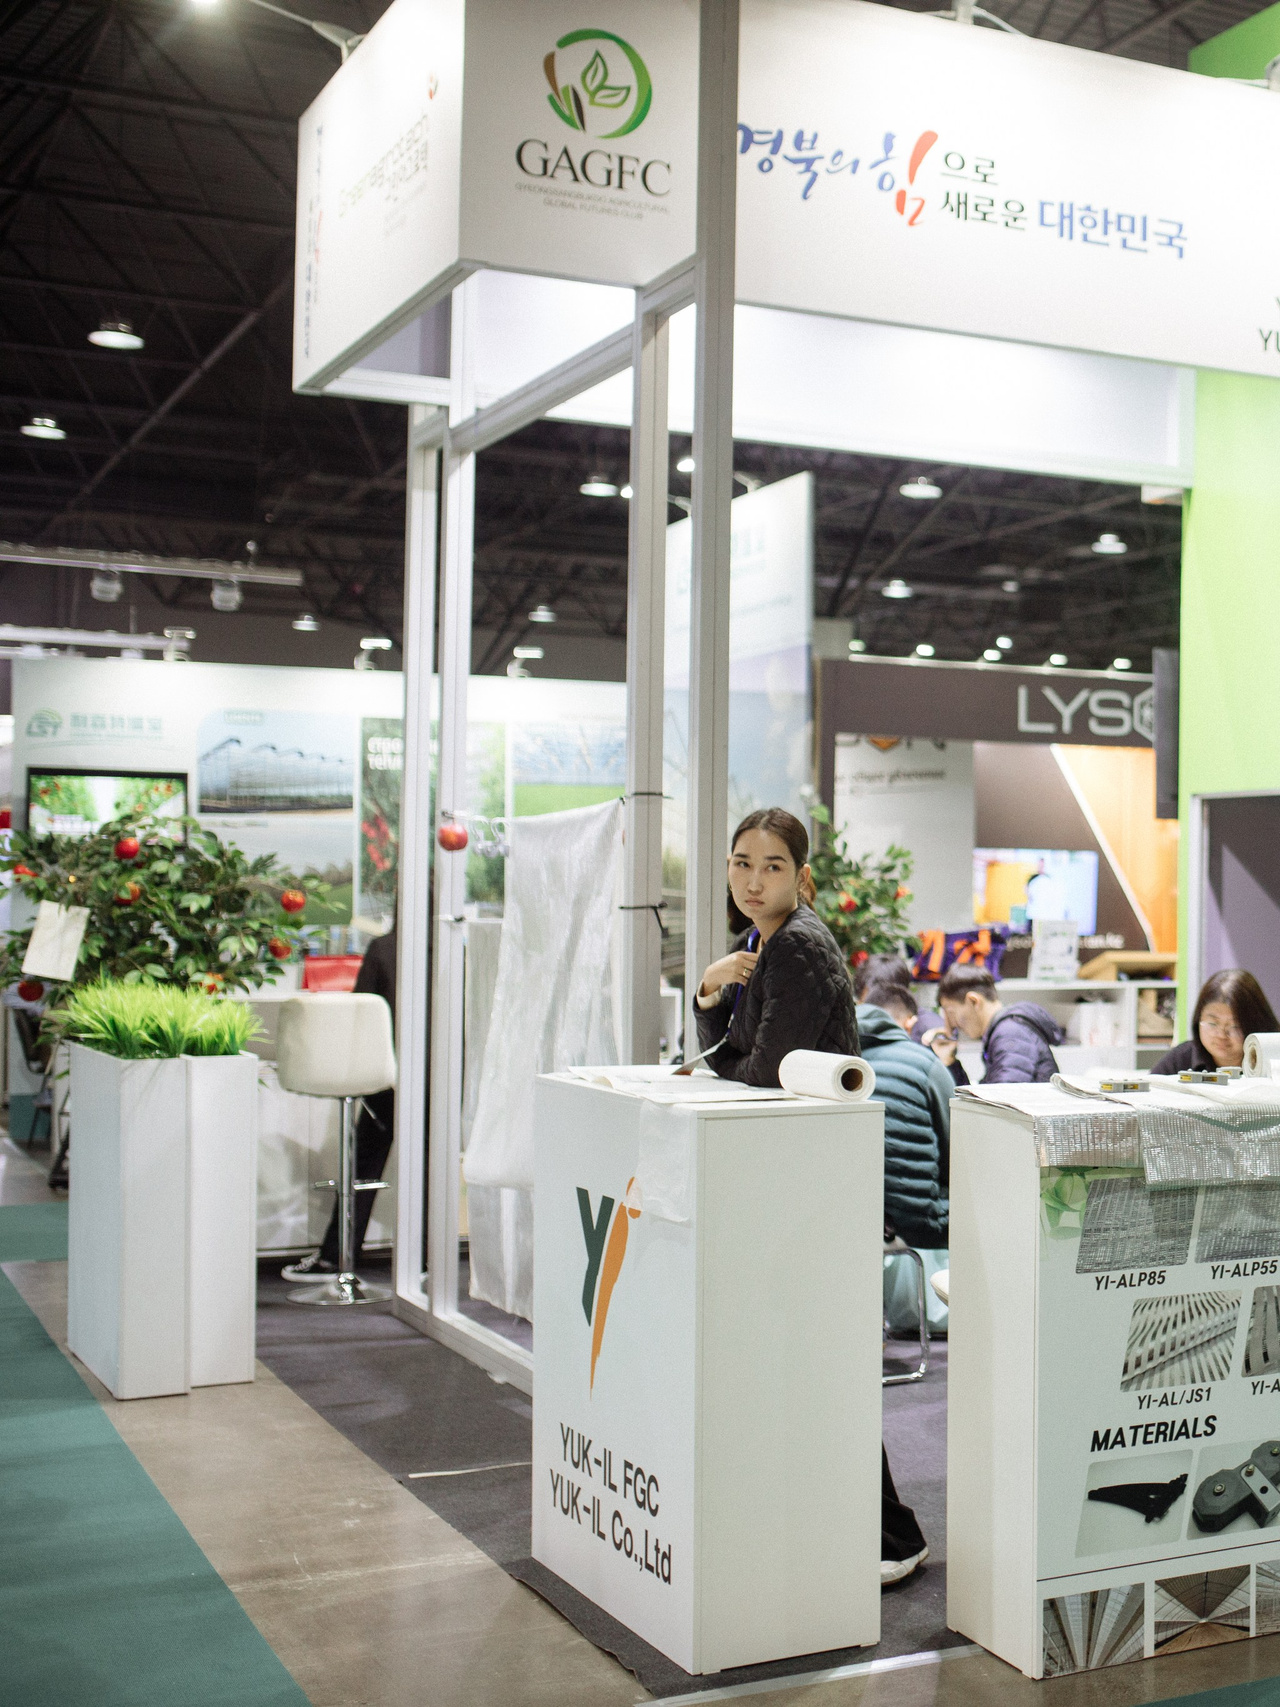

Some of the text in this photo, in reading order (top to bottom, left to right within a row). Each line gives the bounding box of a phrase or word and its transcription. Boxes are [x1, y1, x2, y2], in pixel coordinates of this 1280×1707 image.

[515, 138, 673, 197] GAGFC
[738, 123, 860, 201] 경북의
[939, 190, 1188, 259] 새로운 대한민국
[1094, 1269, 1167, 1292] YI-ALP85
[1210, 1259, 1279, 1281] YI-ALP55
[1137, 1386, 1213, 1411] YI-AL/JS1
[1090, 1414, 1218, 1453] MATERIALS
[559, 1421, 660, 1518] YUK-IL FGC
[549, 1467, 672, 1586] YUK-IL Co.,Ltd
